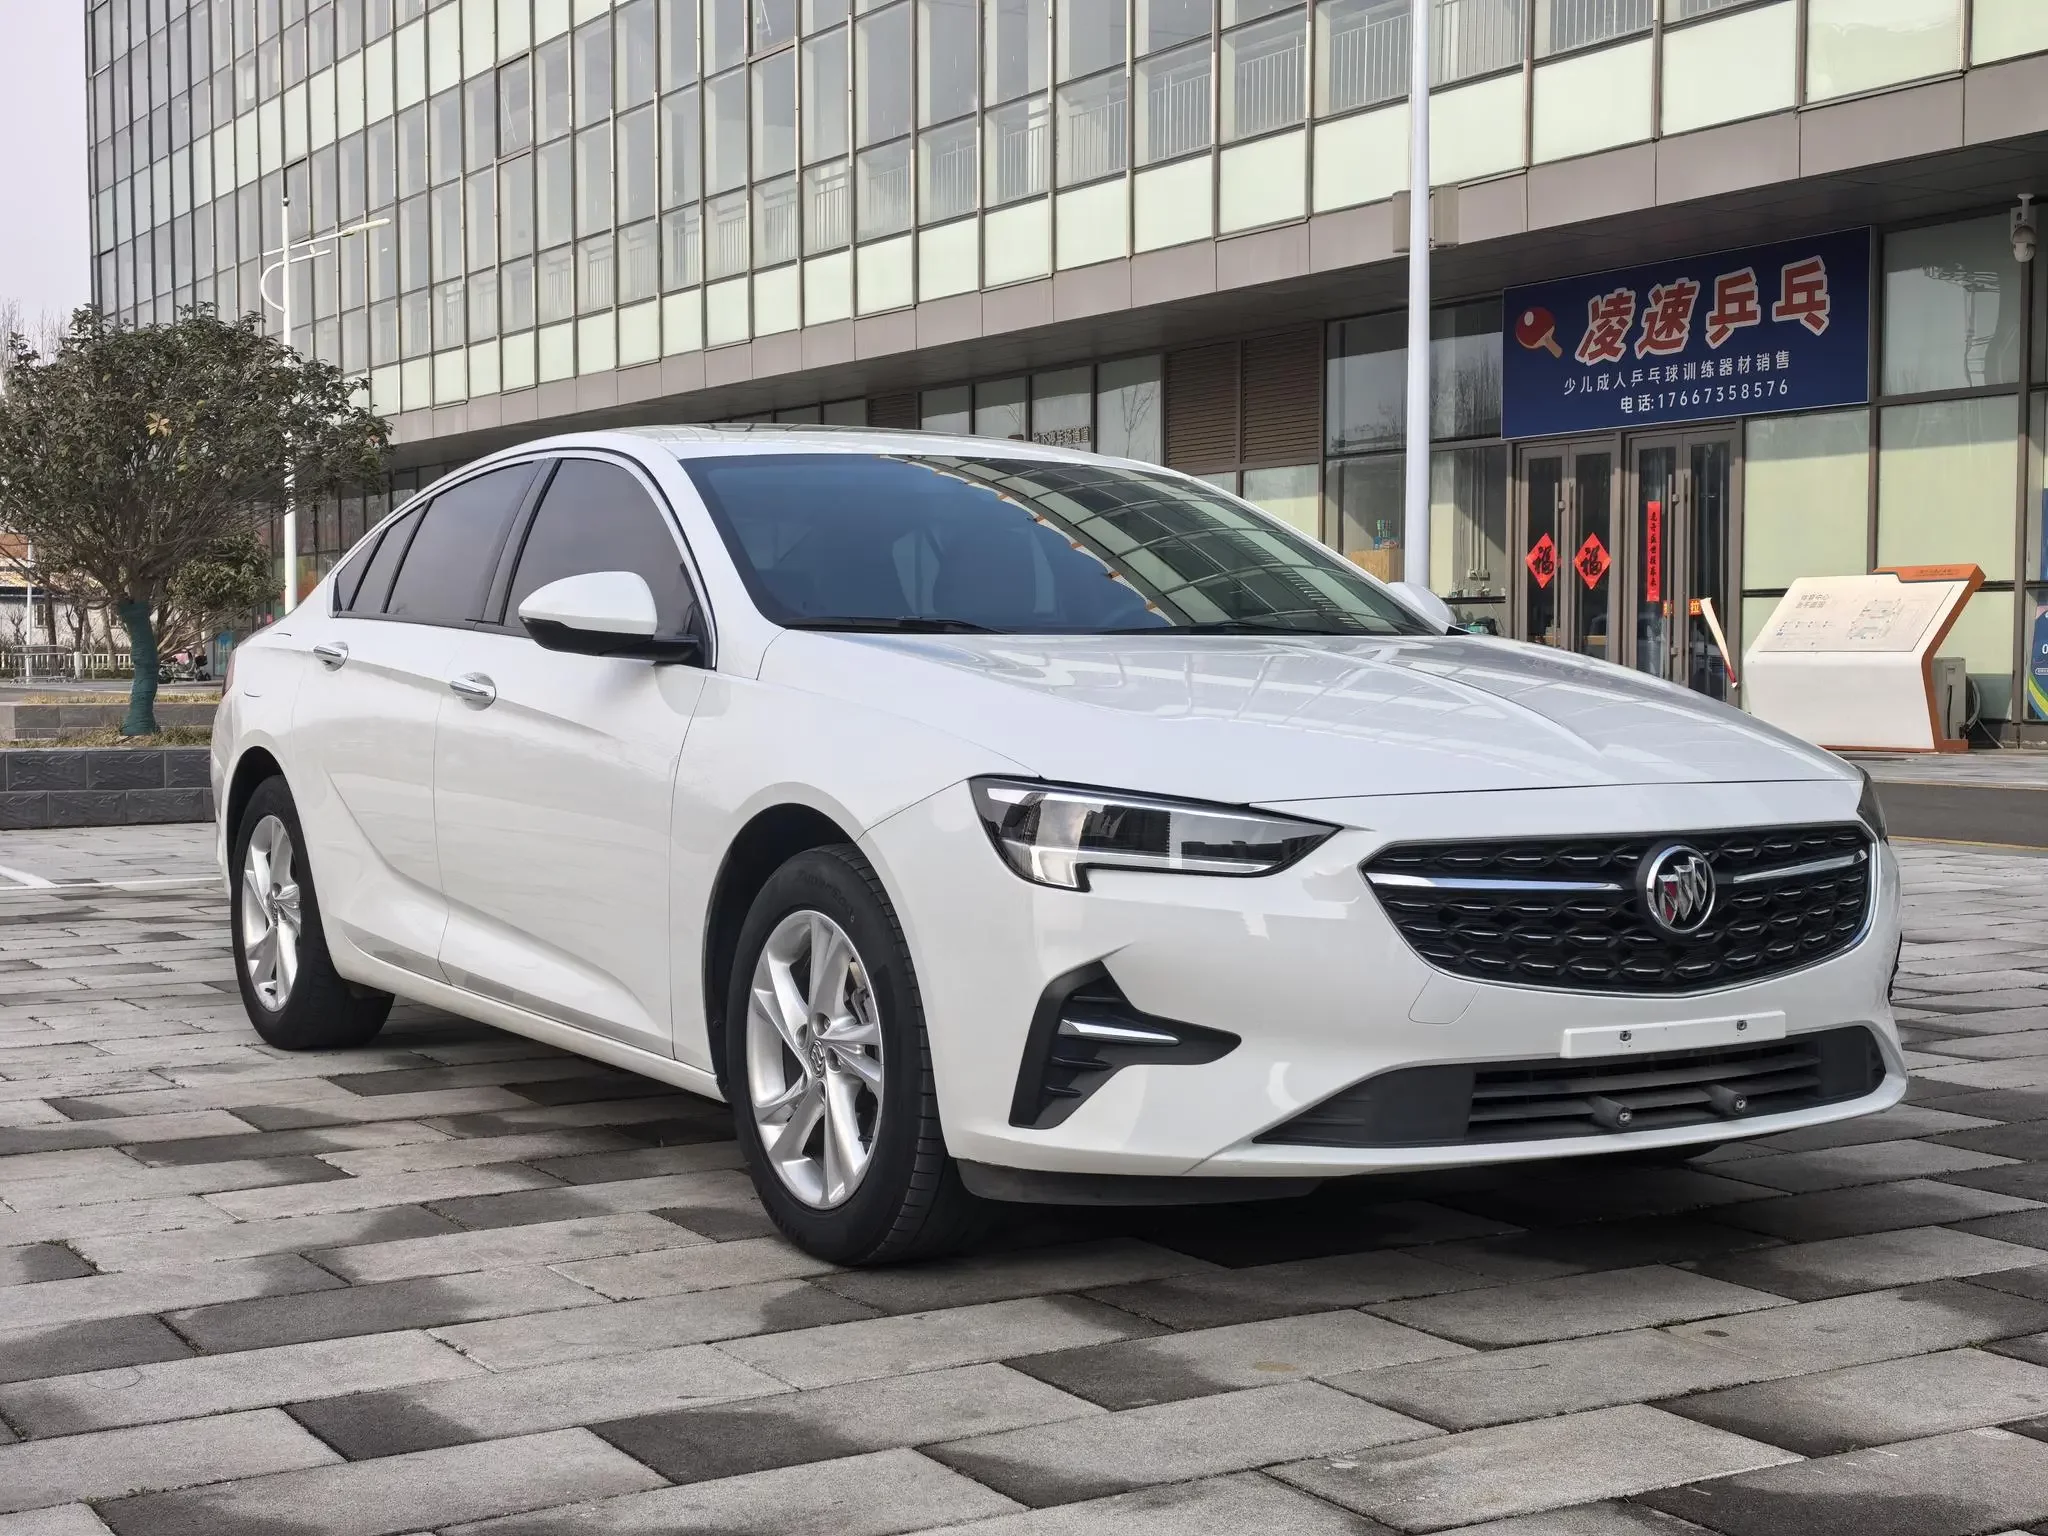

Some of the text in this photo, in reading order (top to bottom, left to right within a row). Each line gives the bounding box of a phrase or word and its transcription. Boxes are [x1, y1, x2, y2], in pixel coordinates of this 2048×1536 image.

[1575, 256, 1830, 365] 凌速乒乓
[1564, 350, 1790, 395] 少儿成人乒乓球训练器材销售
[1620, 379, 1788, 413] 电话:17667358576
